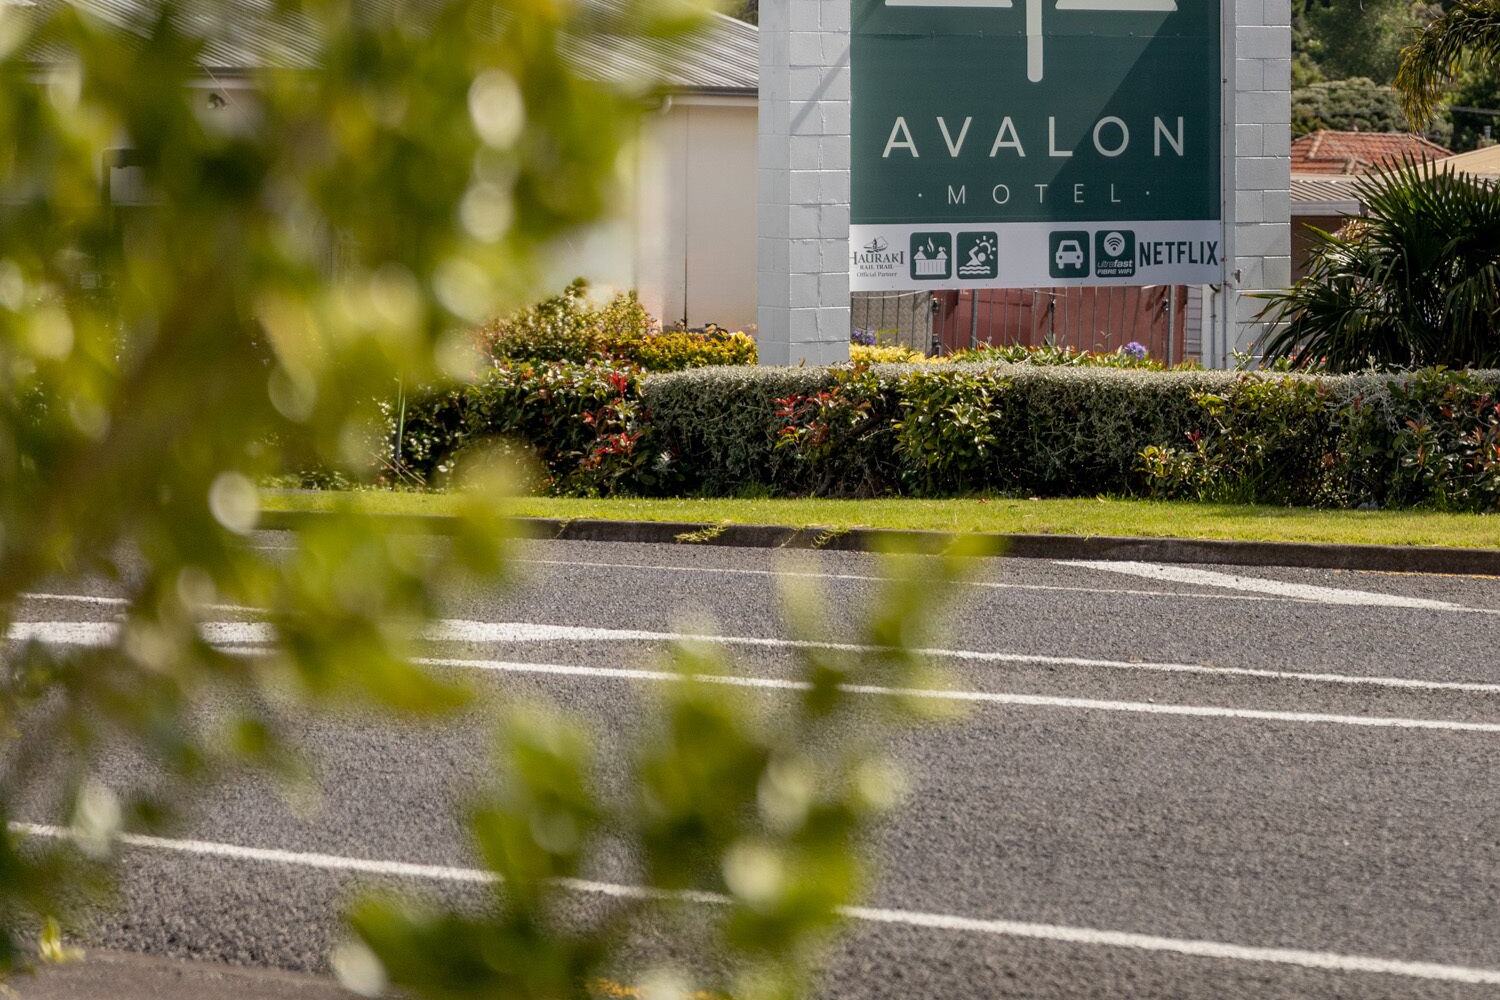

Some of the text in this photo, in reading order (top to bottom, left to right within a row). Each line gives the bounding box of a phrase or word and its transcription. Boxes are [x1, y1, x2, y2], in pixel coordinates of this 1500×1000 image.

[882, 116, 1184, 158] AVALON
[947, 183, 1121, 204] MOTEL
[1139, 241, 1218, 267] NETFLIX
